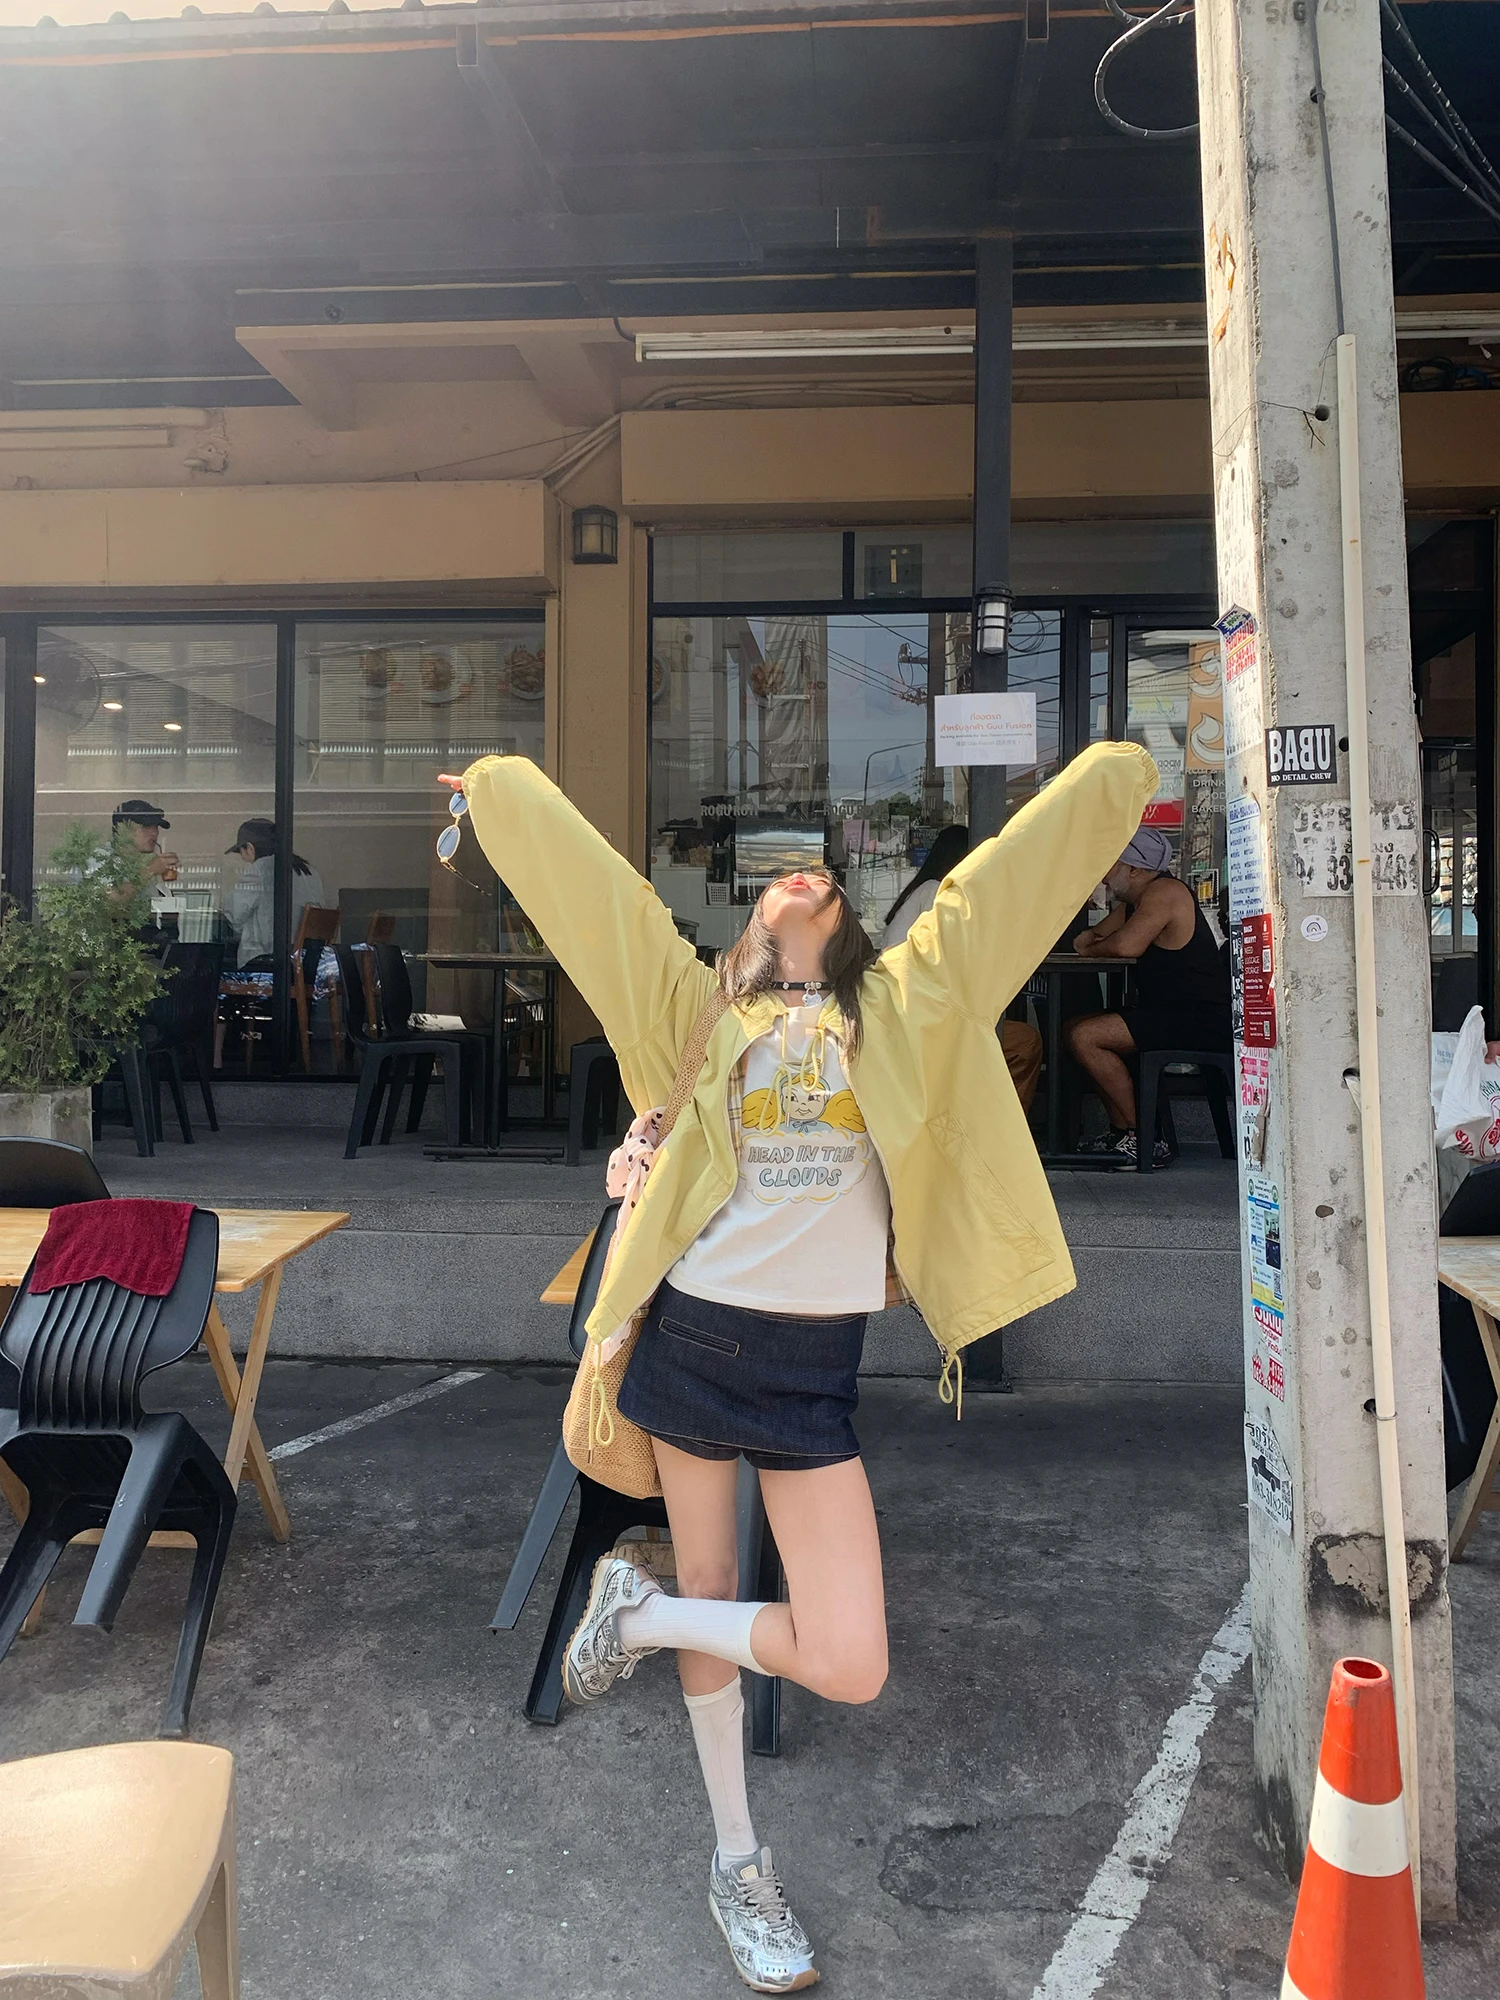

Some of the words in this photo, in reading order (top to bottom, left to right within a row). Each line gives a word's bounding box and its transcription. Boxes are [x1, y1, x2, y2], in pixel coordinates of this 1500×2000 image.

[1282, 773, 1308, 781] DETAIL
[1310, 772, 1332, 780] CREW
[748, 1146, 795, 1164] HEAD
[796, 1145, 819, 1162] IN
[821, 1145, 857, 1163] THE
[759, 1167, 842, 1187] CLOUDS
